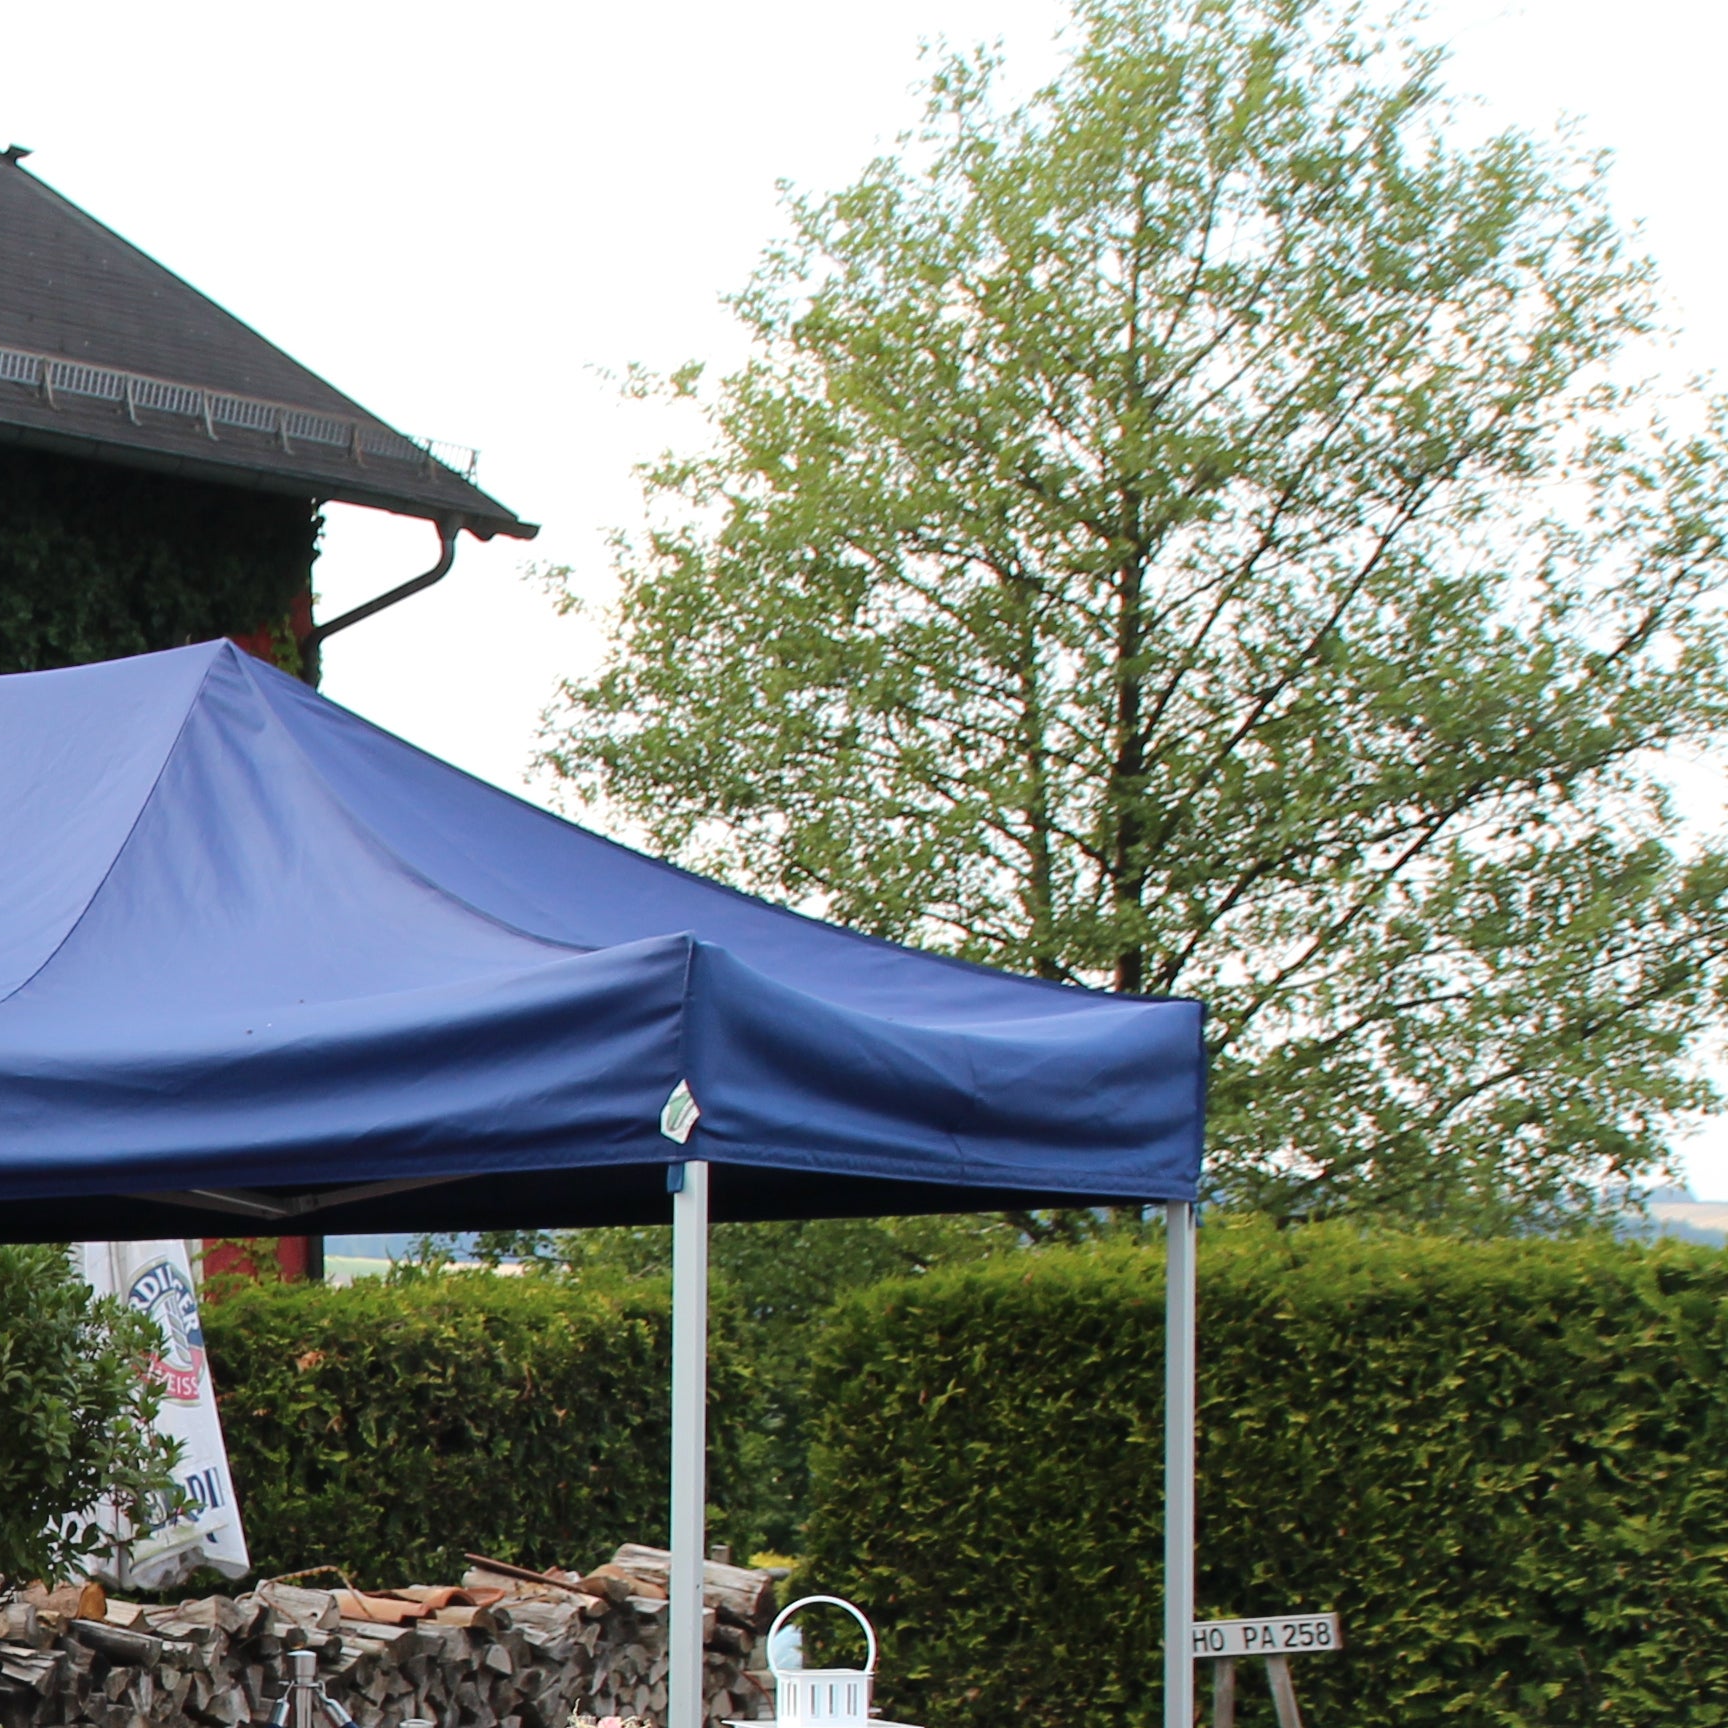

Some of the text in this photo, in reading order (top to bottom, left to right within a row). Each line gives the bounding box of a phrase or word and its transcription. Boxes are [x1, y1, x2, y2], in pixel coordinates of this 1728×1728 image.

[1193, 1622, 1331, 1652] HO PA 258
